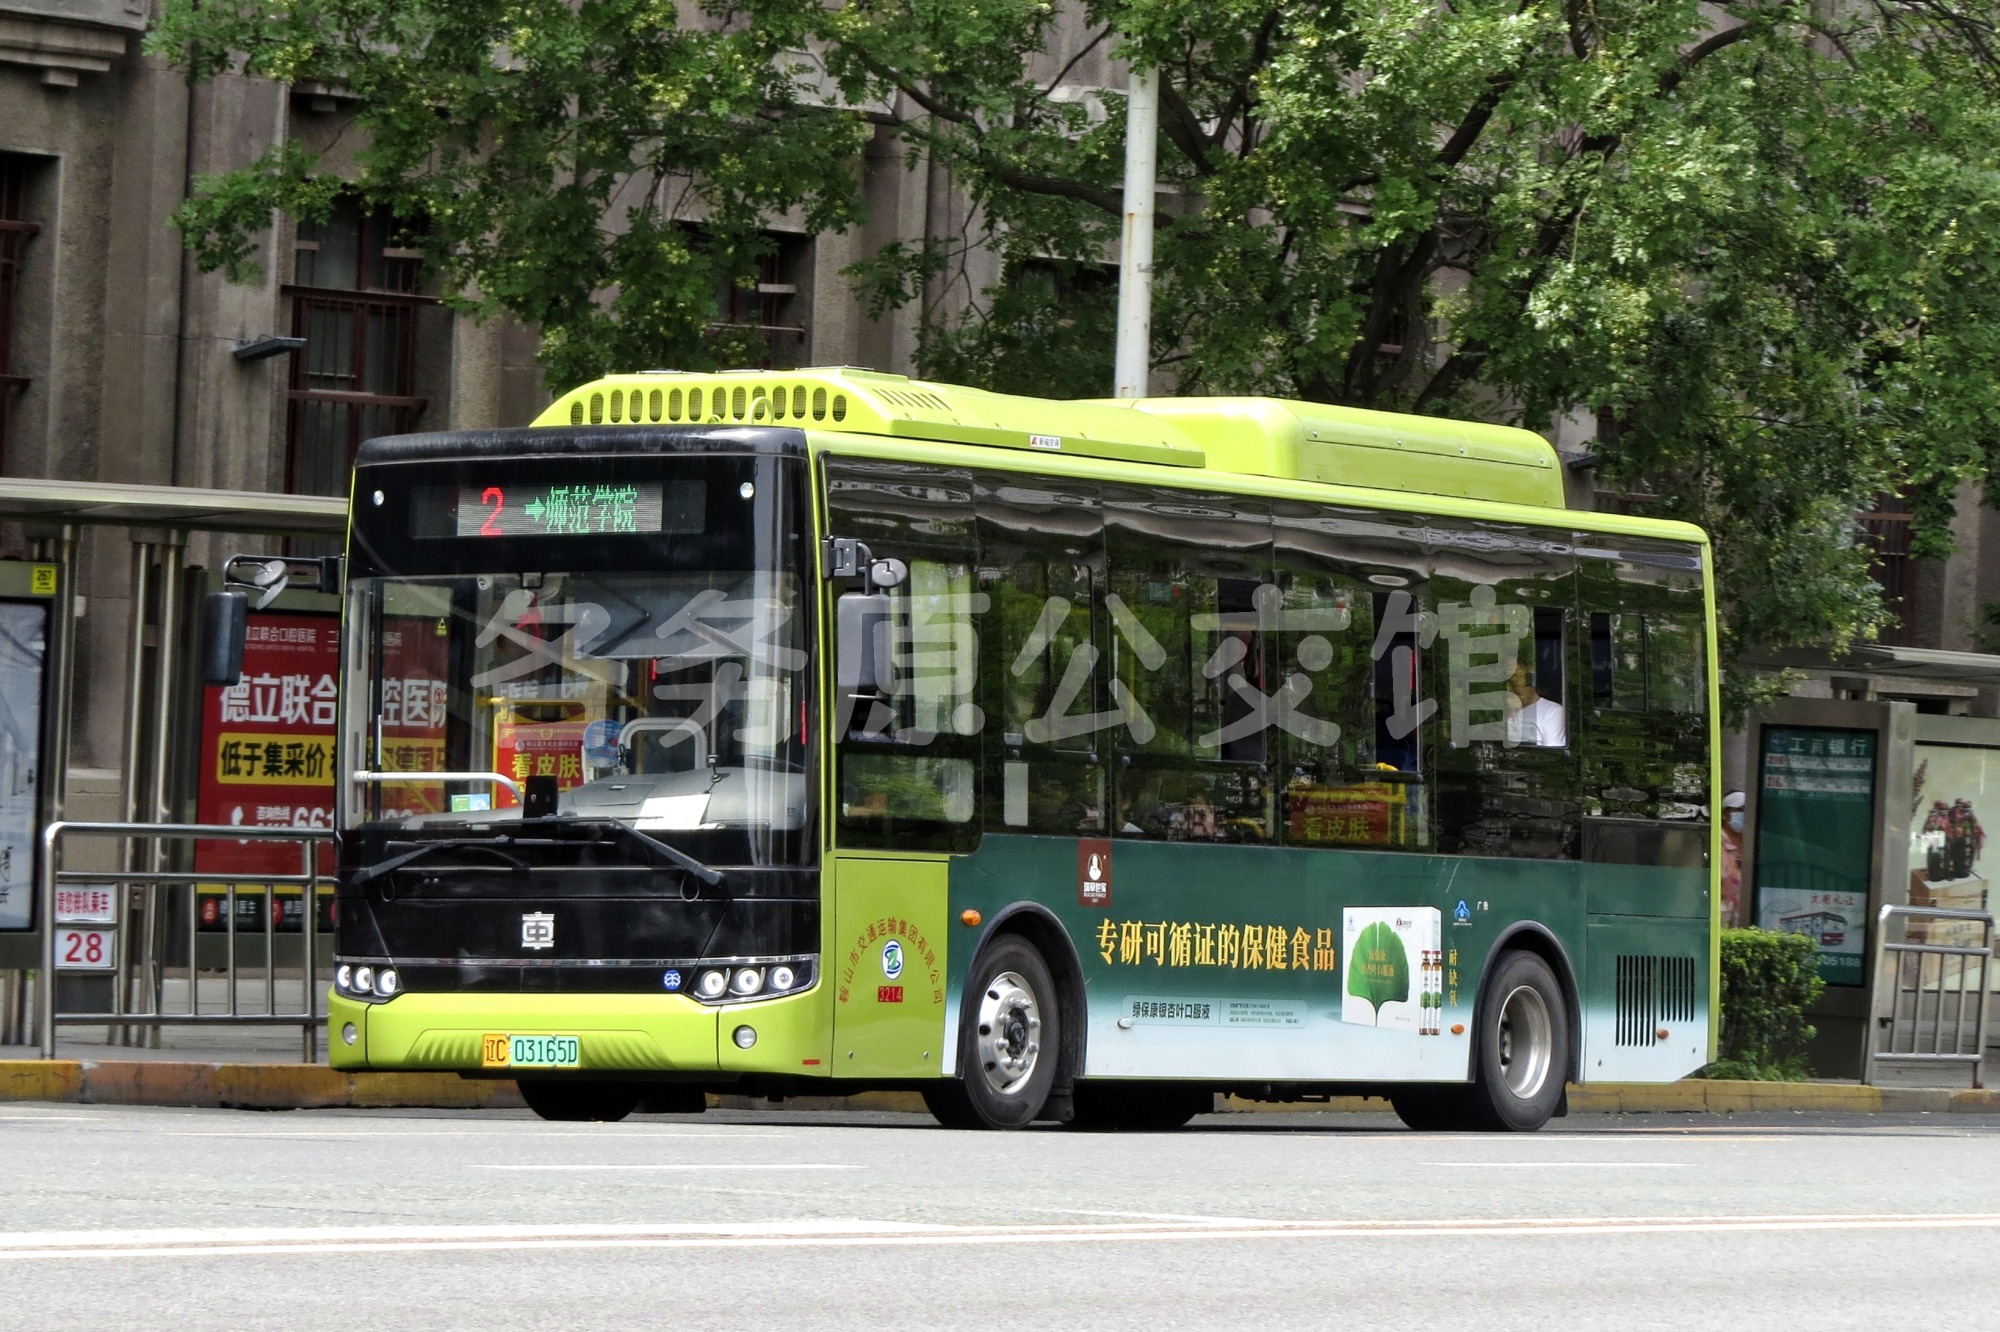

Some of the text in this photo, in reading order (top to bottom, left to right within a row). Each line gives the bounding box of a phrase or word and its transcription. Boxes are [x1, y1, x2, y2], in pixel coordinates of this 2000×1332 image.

[480, 487, 505, 536] 2
[221, 741, 325, 778] 低于集采价
[512, 752, 580, 778] 看皮肤
[65, 932, 103, 963] 28
[839, 916, 944, 1004] 鞍山市交通运输集团有限公司
[1096, 918, 1335, 972] 专研可循证的保健食品
[879, 987, 902, 1002] 3214
[1132, 1001, 1211, 1020] 绿保康银杏叶口服液
